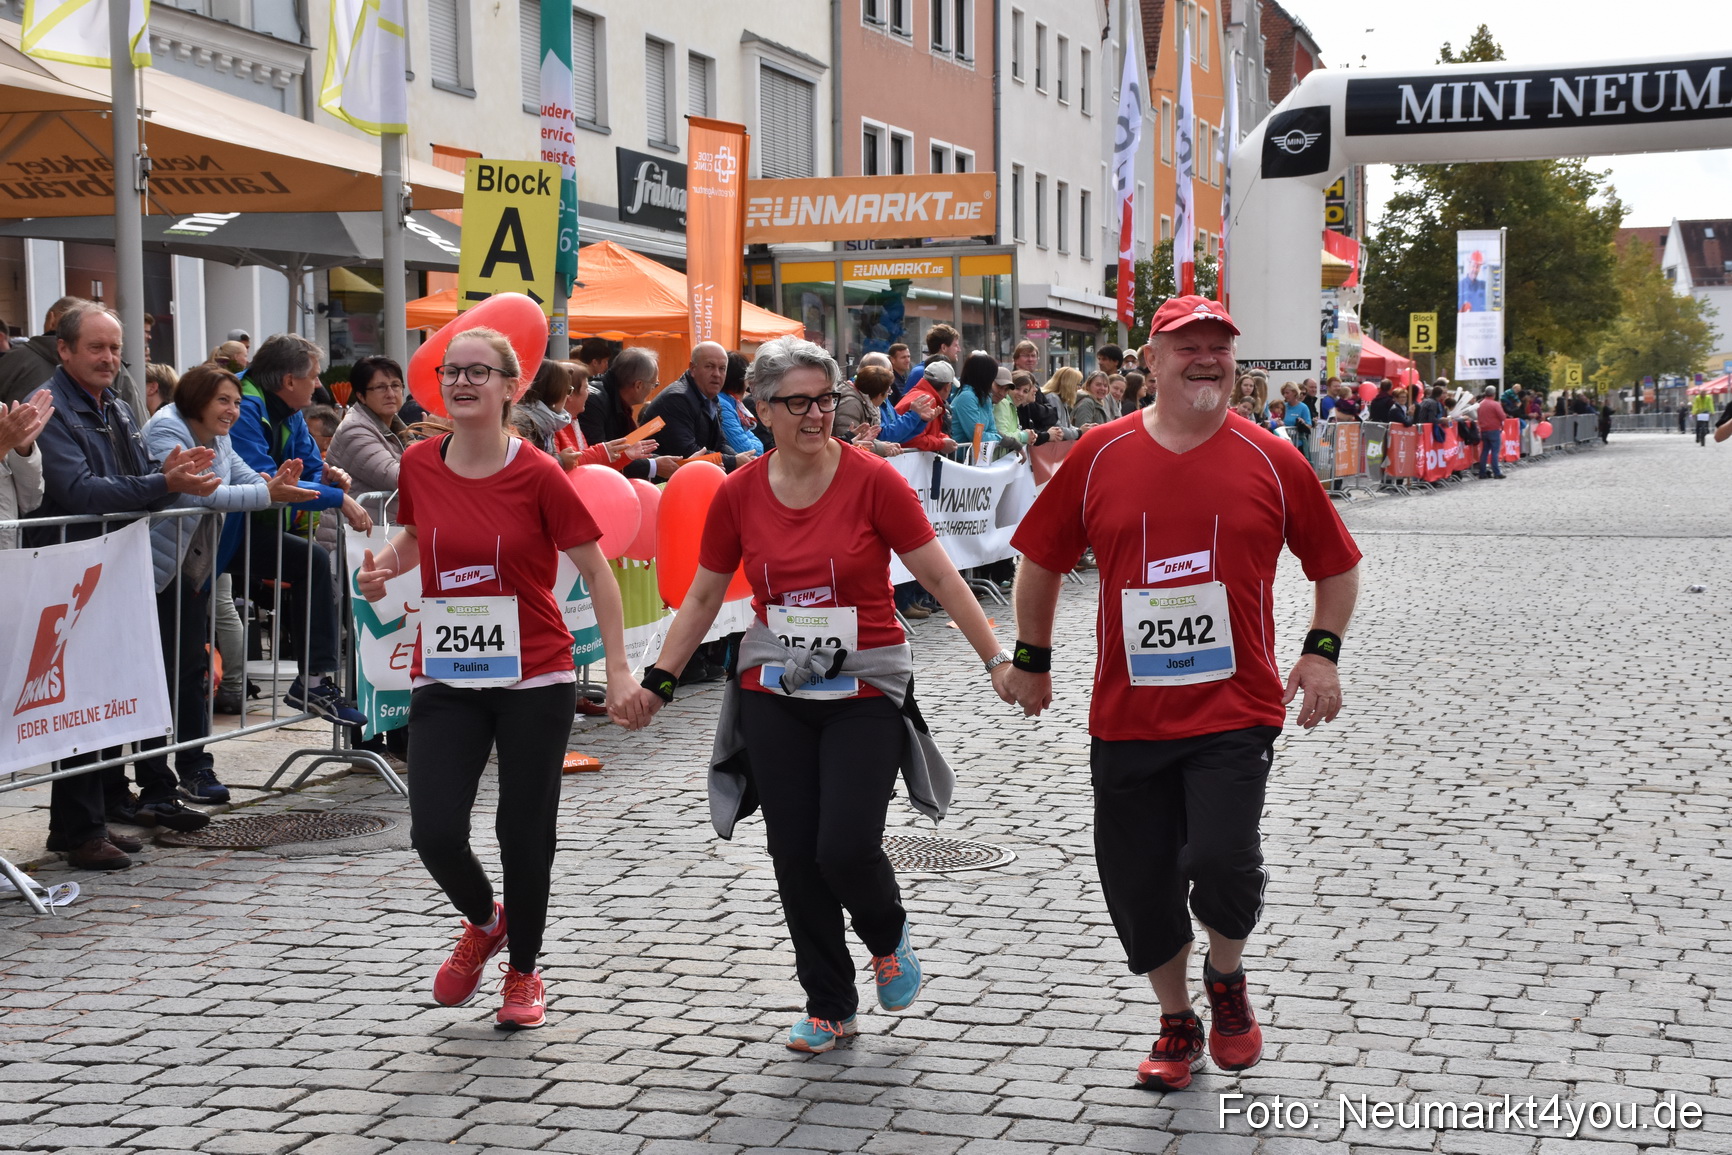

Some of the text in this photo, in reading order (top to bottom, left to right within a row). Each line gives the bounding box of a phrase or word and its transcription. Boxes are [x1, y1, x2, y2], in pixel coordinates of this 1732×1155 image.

[1396, 66, 1732, 125] MINI NEUM
[477, 164, 551, 196] Block
[746, 191, 983, 227] RUNMARKT.DE
[479, 206, 535, 282] A
[853, 262, 944, 277] RUNMARKT.DE
[1417, 324, 1430, 343] B
[1570, 370, 1578, 381] C
[938, 486, 992, 513] YNAMICS.
[455, 570, 480, 583] DEHN
[1164, 560, 1193, 574] DEHN
[456, 605, 489, 614] BOCK
[1160, 595, 1196, 607] BOCK
[436, 624, 505, 653] 2544
[1138, 614, 1216, 649] 2542
[453, 662, 489, 672] Paulina
[1166, 656, 1195, 669] Josef
[16, 665, 62, 712] DKMS
[17, 698, 138, 744] JEDER EINZELNE ZÄHLT
